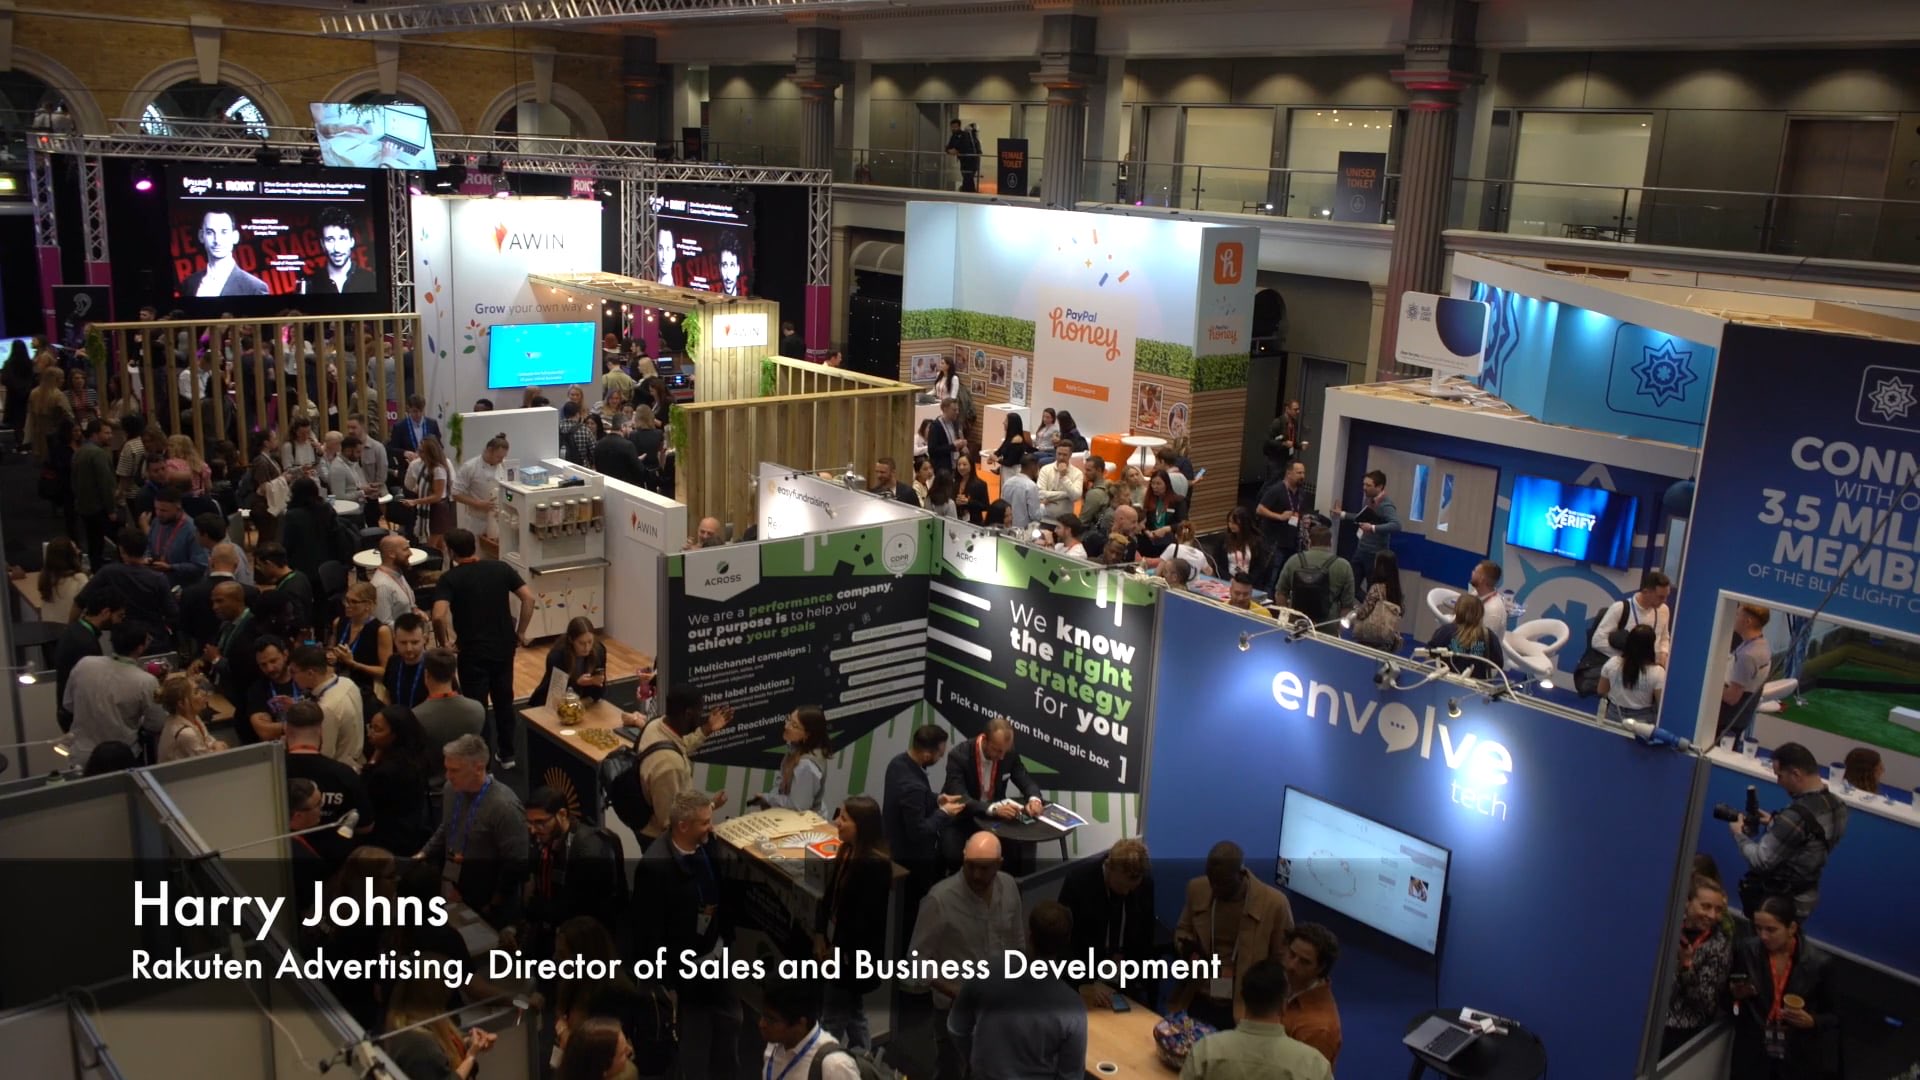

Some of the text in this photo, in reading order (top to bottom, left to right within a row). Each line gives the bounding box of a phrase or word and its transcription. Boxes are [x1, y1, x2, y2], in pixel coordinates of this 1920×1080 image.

[1001, 151, 1025, 160] FEMALE
[1002, 160, 1023, 168] TOILET
[225, 180, 256, 192] ROKT
[1345, 167, 1377, 178] UNISEX
[1346, 178, 1374, 189] TOILET
[509, 233, 565, 250] AWIN
[474, 302, 583, 316] Grow your own way
[1065, 308, 1098, 323] PayPal
[1048, 306, 1121, 362] honey
[1834, 479, 1895, 507] WITH
[1551, 508, 1596, 532] VERIFY
[1757, 488, 1822, 532] 3.5
[636, 520, 659, 539] AWIN
[704, 574, 742, 587] ACROSS
[1747, 563, 1771, 579] OF
[1773, 567, 1805, 588] THE
[1808, 576, 1850, 598] BLUE
[1852, 585, 1905, 609] LIGHT
[687, 582, 894, 625] We are a performance company,
[688, 600, 857, 640] our purpose is to help you
[1010, 600, 1136, 665] We know
[687, 620, 817, 654] achieve your goals
[694, 655, 757, 675] Multichannel
[757, 645, 807, 663] campaigns
[1010, 627, 1133, 693] the right
[724, 686, 748, 699] label
[748, 676, 790, 693] solutions
[1014, 658, 1132, 721] strategy
[1034, 686, 1129, 745] for you
[972, 703, 980, 713] a
[1006, 715, 1031, 735] from
[1032, 727, 1051, 743] the
[1053, 737, 1087, 758] magic
[1089, 750, 1110, 770] box
[1450, 778, 1507, 821] tech
